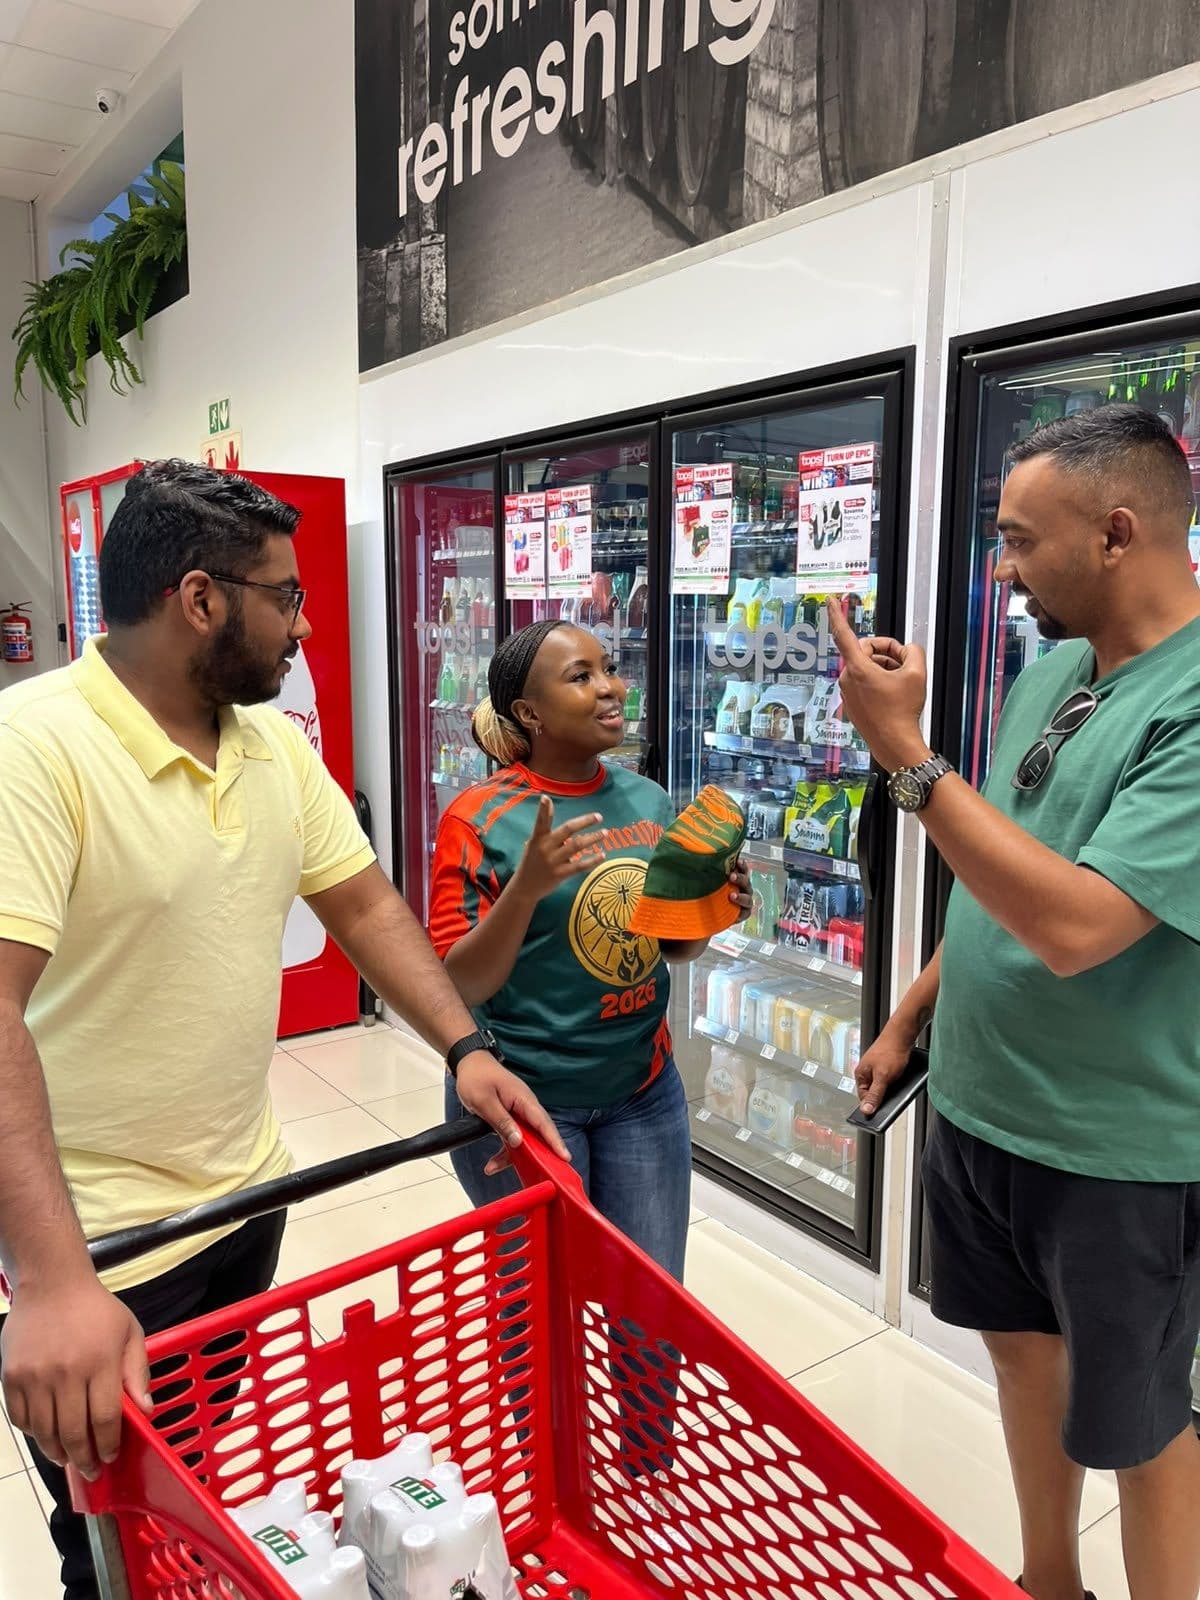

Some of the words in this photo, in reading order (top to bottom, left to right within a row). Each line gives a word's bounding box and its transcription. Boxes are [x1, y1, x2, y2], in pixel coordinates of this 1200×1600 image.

[827, 453, 844, 462] TURN
[845, 452, 855, 460] UP
[855, 449, 871, 458] EPIC
[413, 609, 476, 665] tops!
[702, 605, 829, 684] tops!
[785, 675, 815, 685] SPAR
[793, 823, 826, 843] Savanna
[600, 978, 657, 1020] 2026
[394, 1478, 441, 1506] LITE
[256, 1528, 303, 1561] LITE
